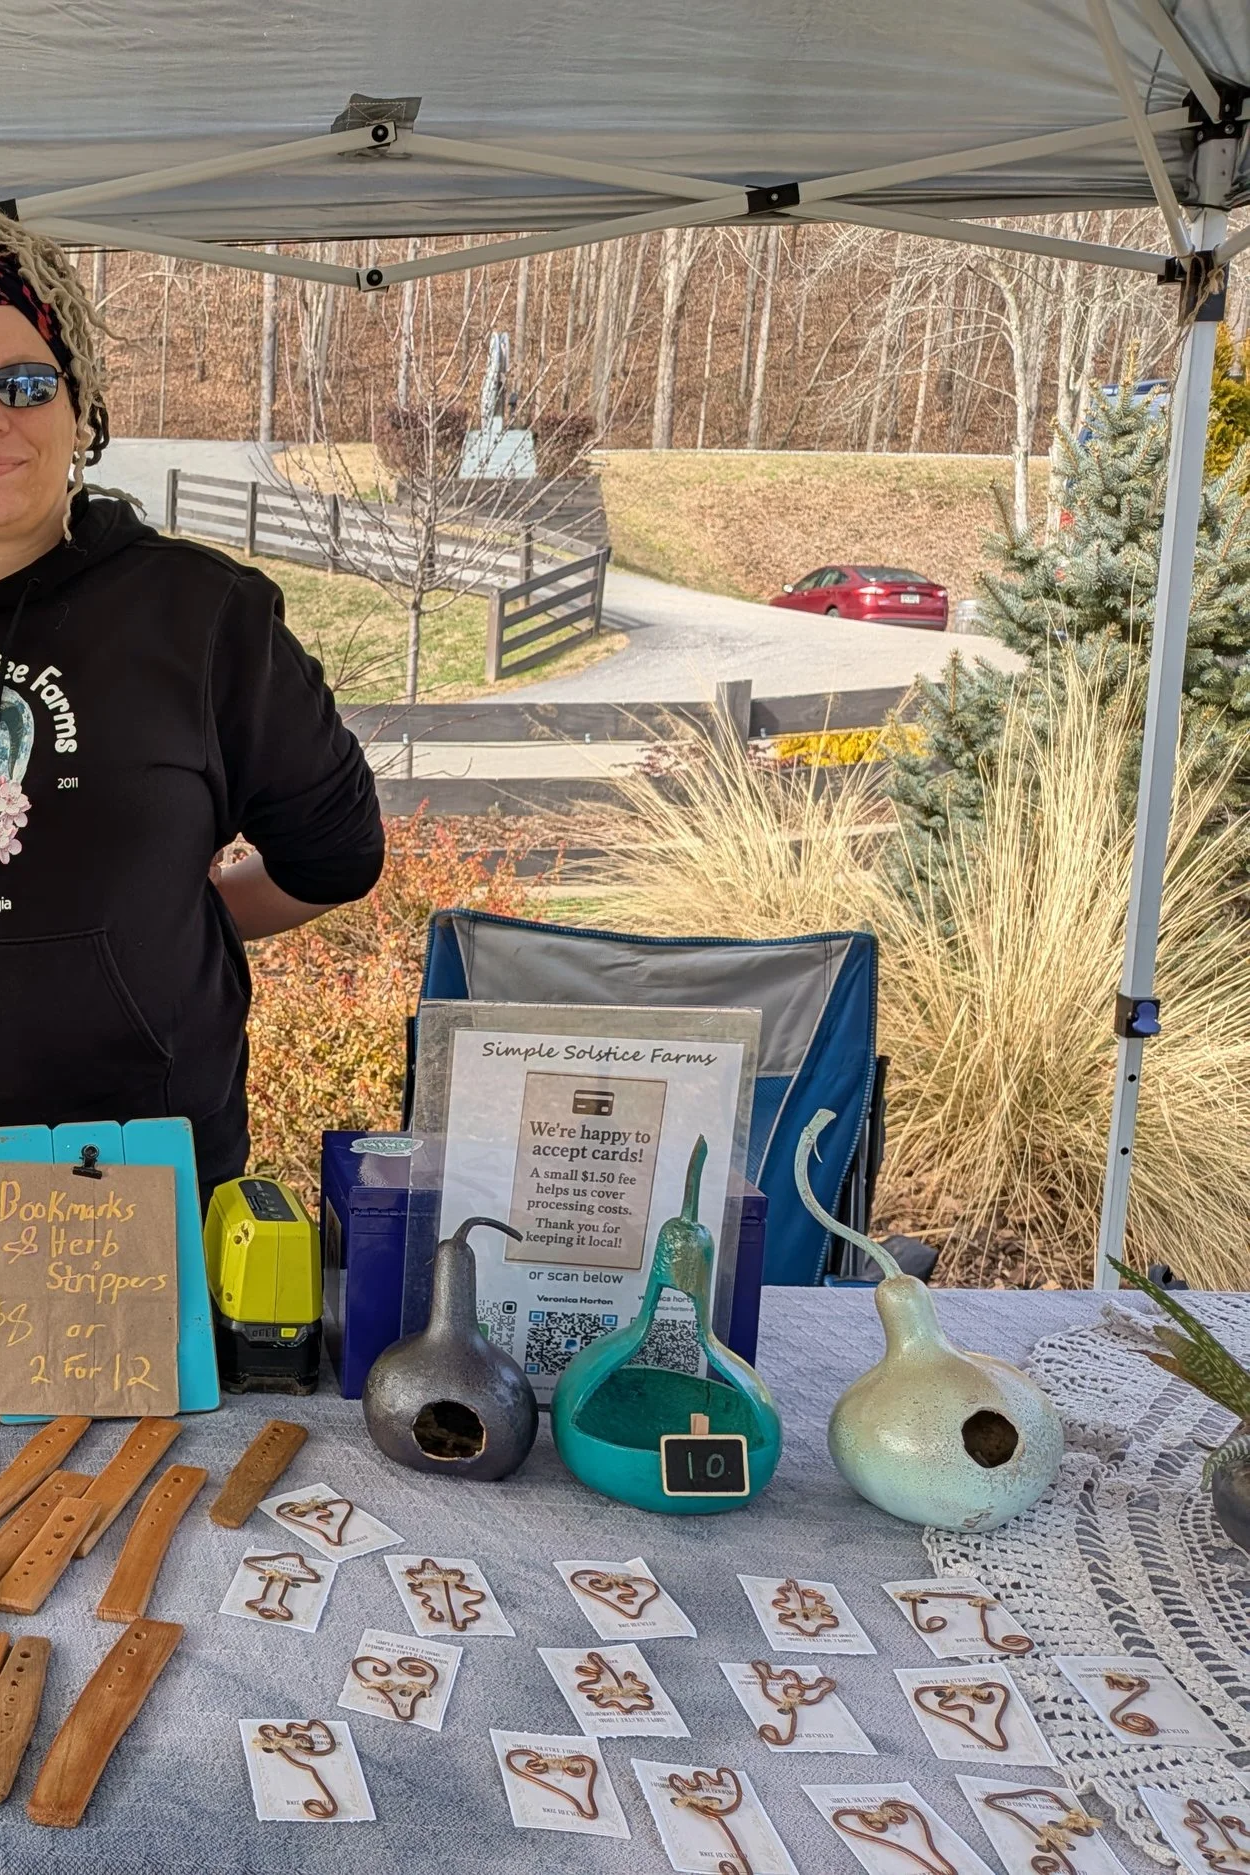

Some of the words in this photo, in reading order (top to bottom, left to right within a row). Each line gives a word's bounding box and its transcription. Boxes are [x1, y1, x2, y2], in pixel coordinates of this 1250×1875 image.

[30, 666, 78, 754] Farms
[57, 777, 79, 789] 2011
[482, 1042, 559, 1060] Simple
[563, 1045, 645, 1062] Solstice
[650, 1048, 718, 1066] Farms
[530, 1121, 577, 1139] We're
[580, 1127, 631, 1146] happy
[635, 1129, 651, 1144] to
[532, 1143, 588, 1163] accept
[592, 1145, 644, 1163] cards!
[529, 1168, 542, 1179] A
[544, 1168, 579, 1182] small
[581, 1171, 615, 1184] $1.50
[617, 1173, 637, 1186] fee
[535, 1183, 569, 1199] helps
[573, 1188, 588, 1198] us
[591, 1189, 626, 1201] cover
[527, 1199, 595, 1217] processing
[597, 1204, 633, 1216] costs.
[535, 1217, 574, 1231] Thank
[577, 1221, 599, 1236] you
[601, 1222, 621, 1235] for
[51, 1225, 120, 1258] Herb
[525, 1233, 573, 1251] keeping
[576, 1236, 586, 1247] it
[588, 1236, 622, 1249] local!
[46, 1260, 168, 1304] Strippers
[528, 1271, 543, 1280] or
[547, 1272, 579, 1282] scan
[582, 1272, 624, 1285] below
[536, 1295, 576, 1304] Veronica
[578, 1297, 614, 1306] Horton
[66, 1323, 106, 1338] or
[29, 1355, 51, 1384] 2
